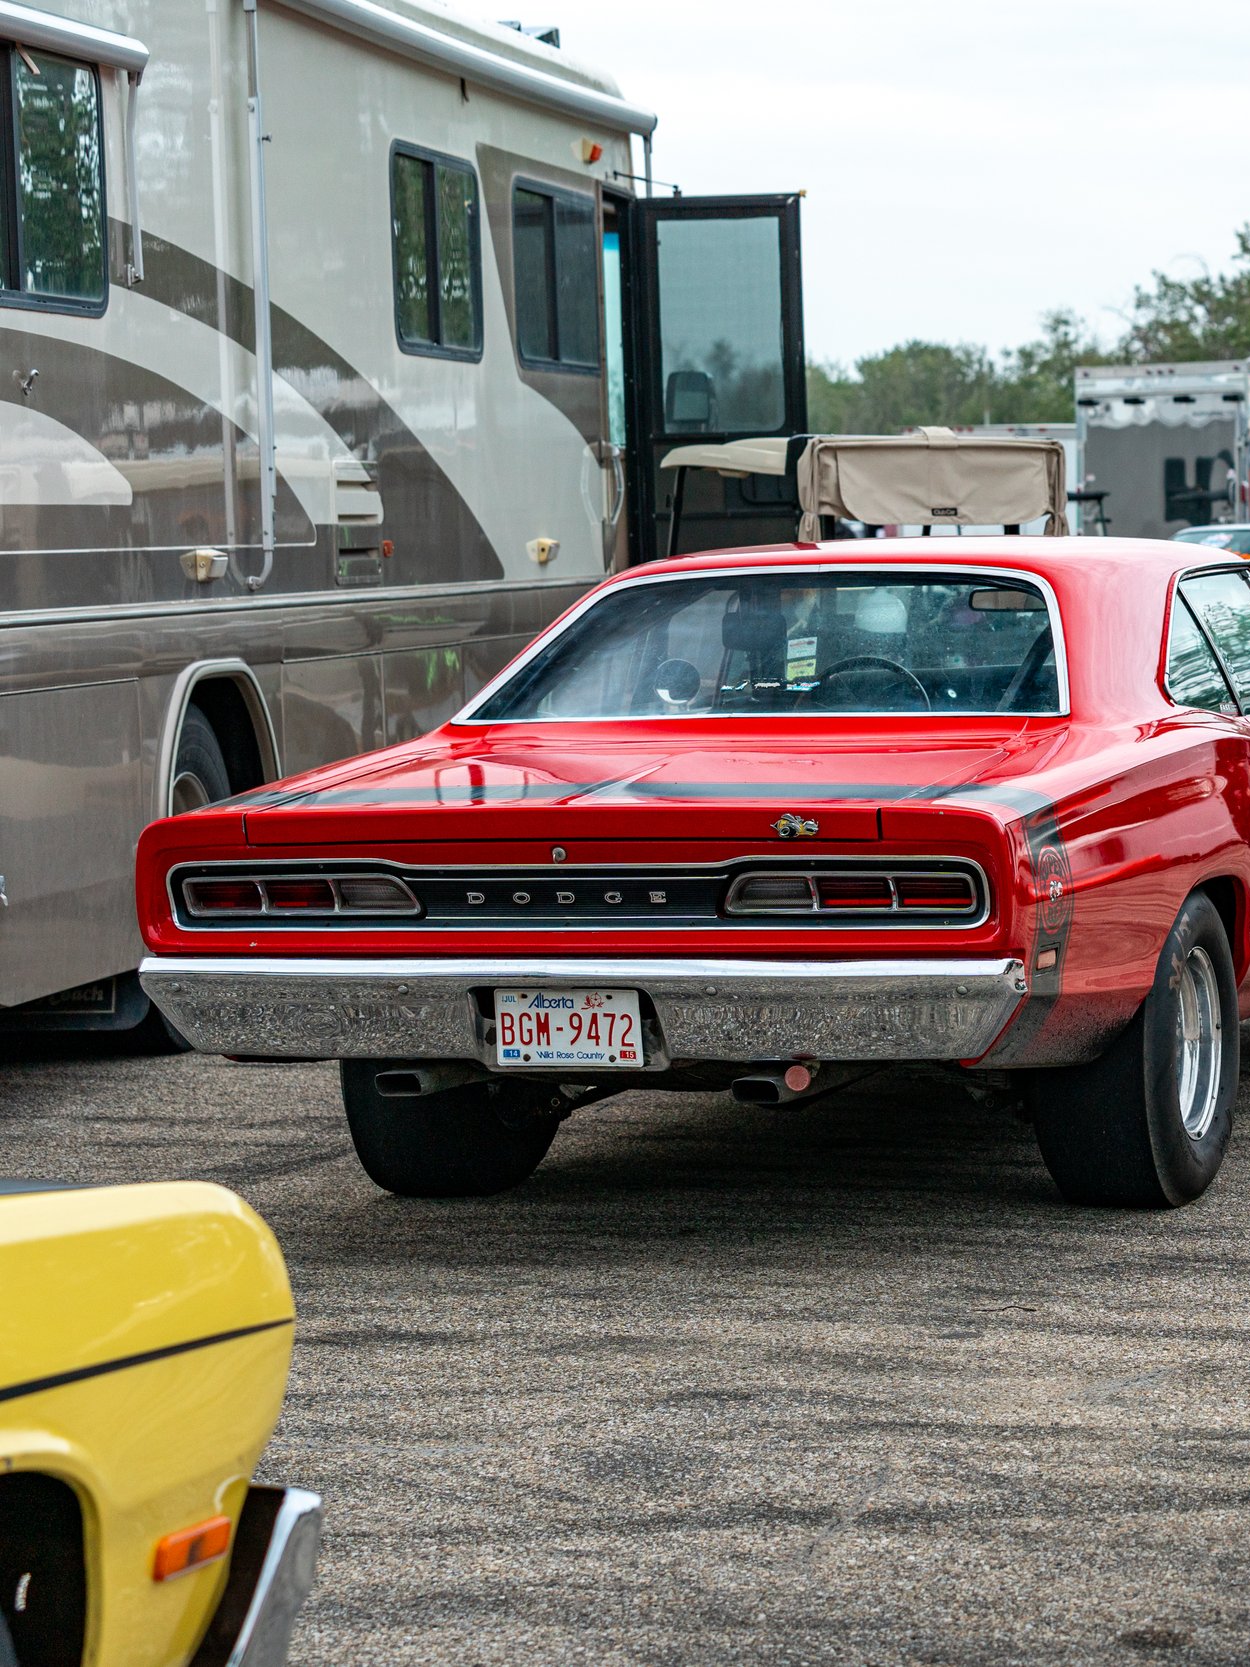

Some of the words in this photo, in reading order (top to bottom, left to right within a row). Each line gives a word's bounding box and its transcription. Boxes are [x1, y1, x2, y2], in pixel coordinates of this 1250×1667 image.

[466, 891, 667, 904] DODGE
[504, 995, 517, 1003] JUL
[528, 992, 574, 1009] Alberta
[500, 1012, 635, 1047] BGM-9472
[536, 1051, 554, 1059] Wild
[556, 1051, 574, 1059] Rose
[577, 1051, 605, 1061] Country
